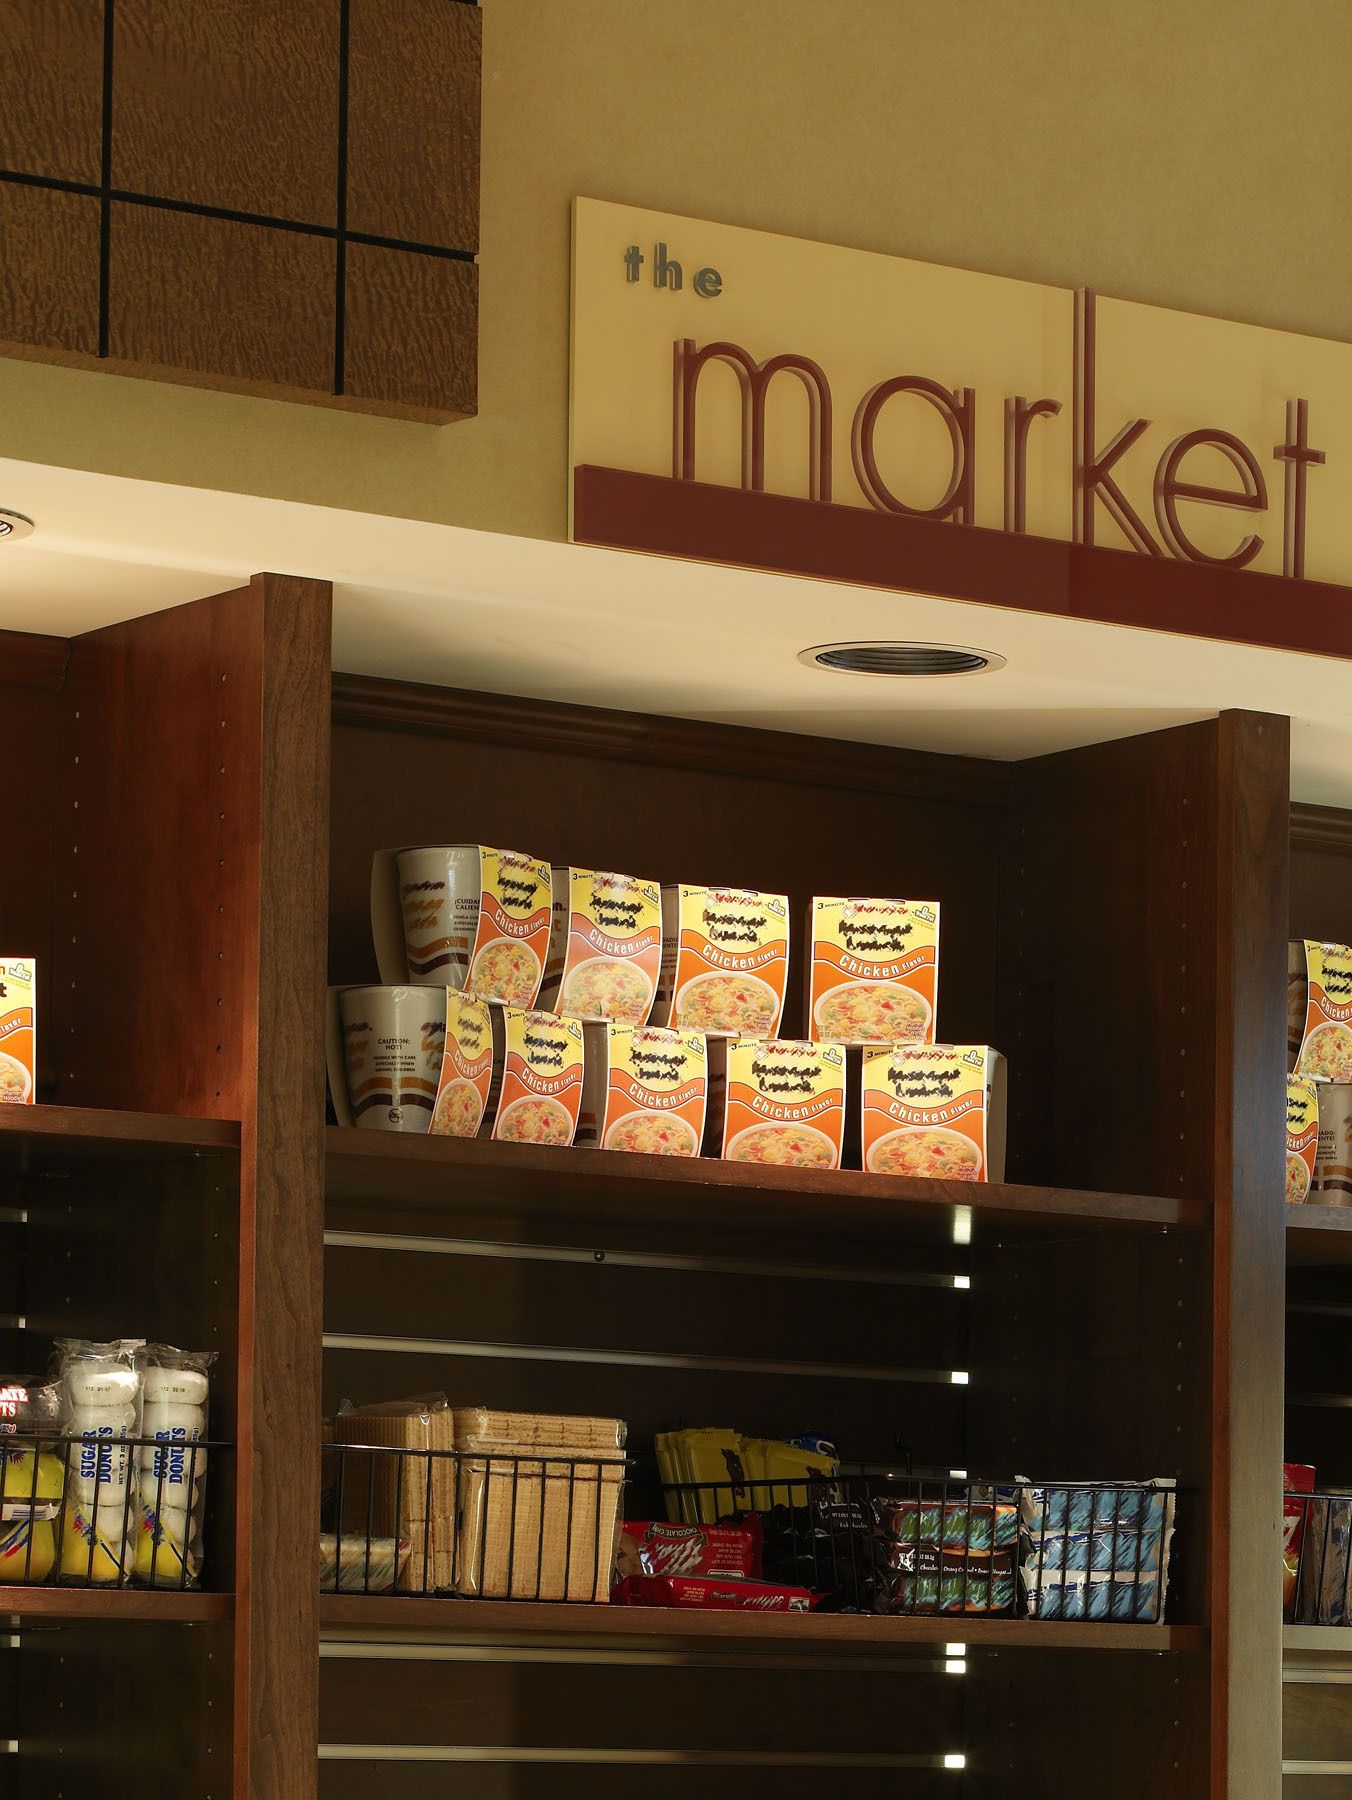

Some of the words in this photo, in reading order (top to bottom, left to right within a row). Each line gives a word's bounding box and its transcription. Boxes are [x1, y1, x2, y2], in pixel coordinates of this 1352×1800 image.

[624, 242, 724, 299] the
[673, 287, 1326, 580] market
[495, 908, 529, 936] Chicken
[590, 928, 634, 954] Chicken
[702, 944, 754, 969] Chicken
[757, 949, 777, 964] Flavor
[839, 954, 899, 977] Chicken
[902, 955, 925, 970] Flavor
[1321, 997, 1350, 1019] Chicken
[455, 1051, 478, 1075] Chicken
[522, 1069, 559, 1092] Chicken
[629, 1084, 676, 1108] Chicken
[678, 1087, 698, 1102] Flavor
[752, 1097, 808, 1119] Chicken
[811, 1098, 833, 1113] Flavor
[889, 1102, 948, 1123] Chicken
[950, 1100, 973, 1115] Flavor
